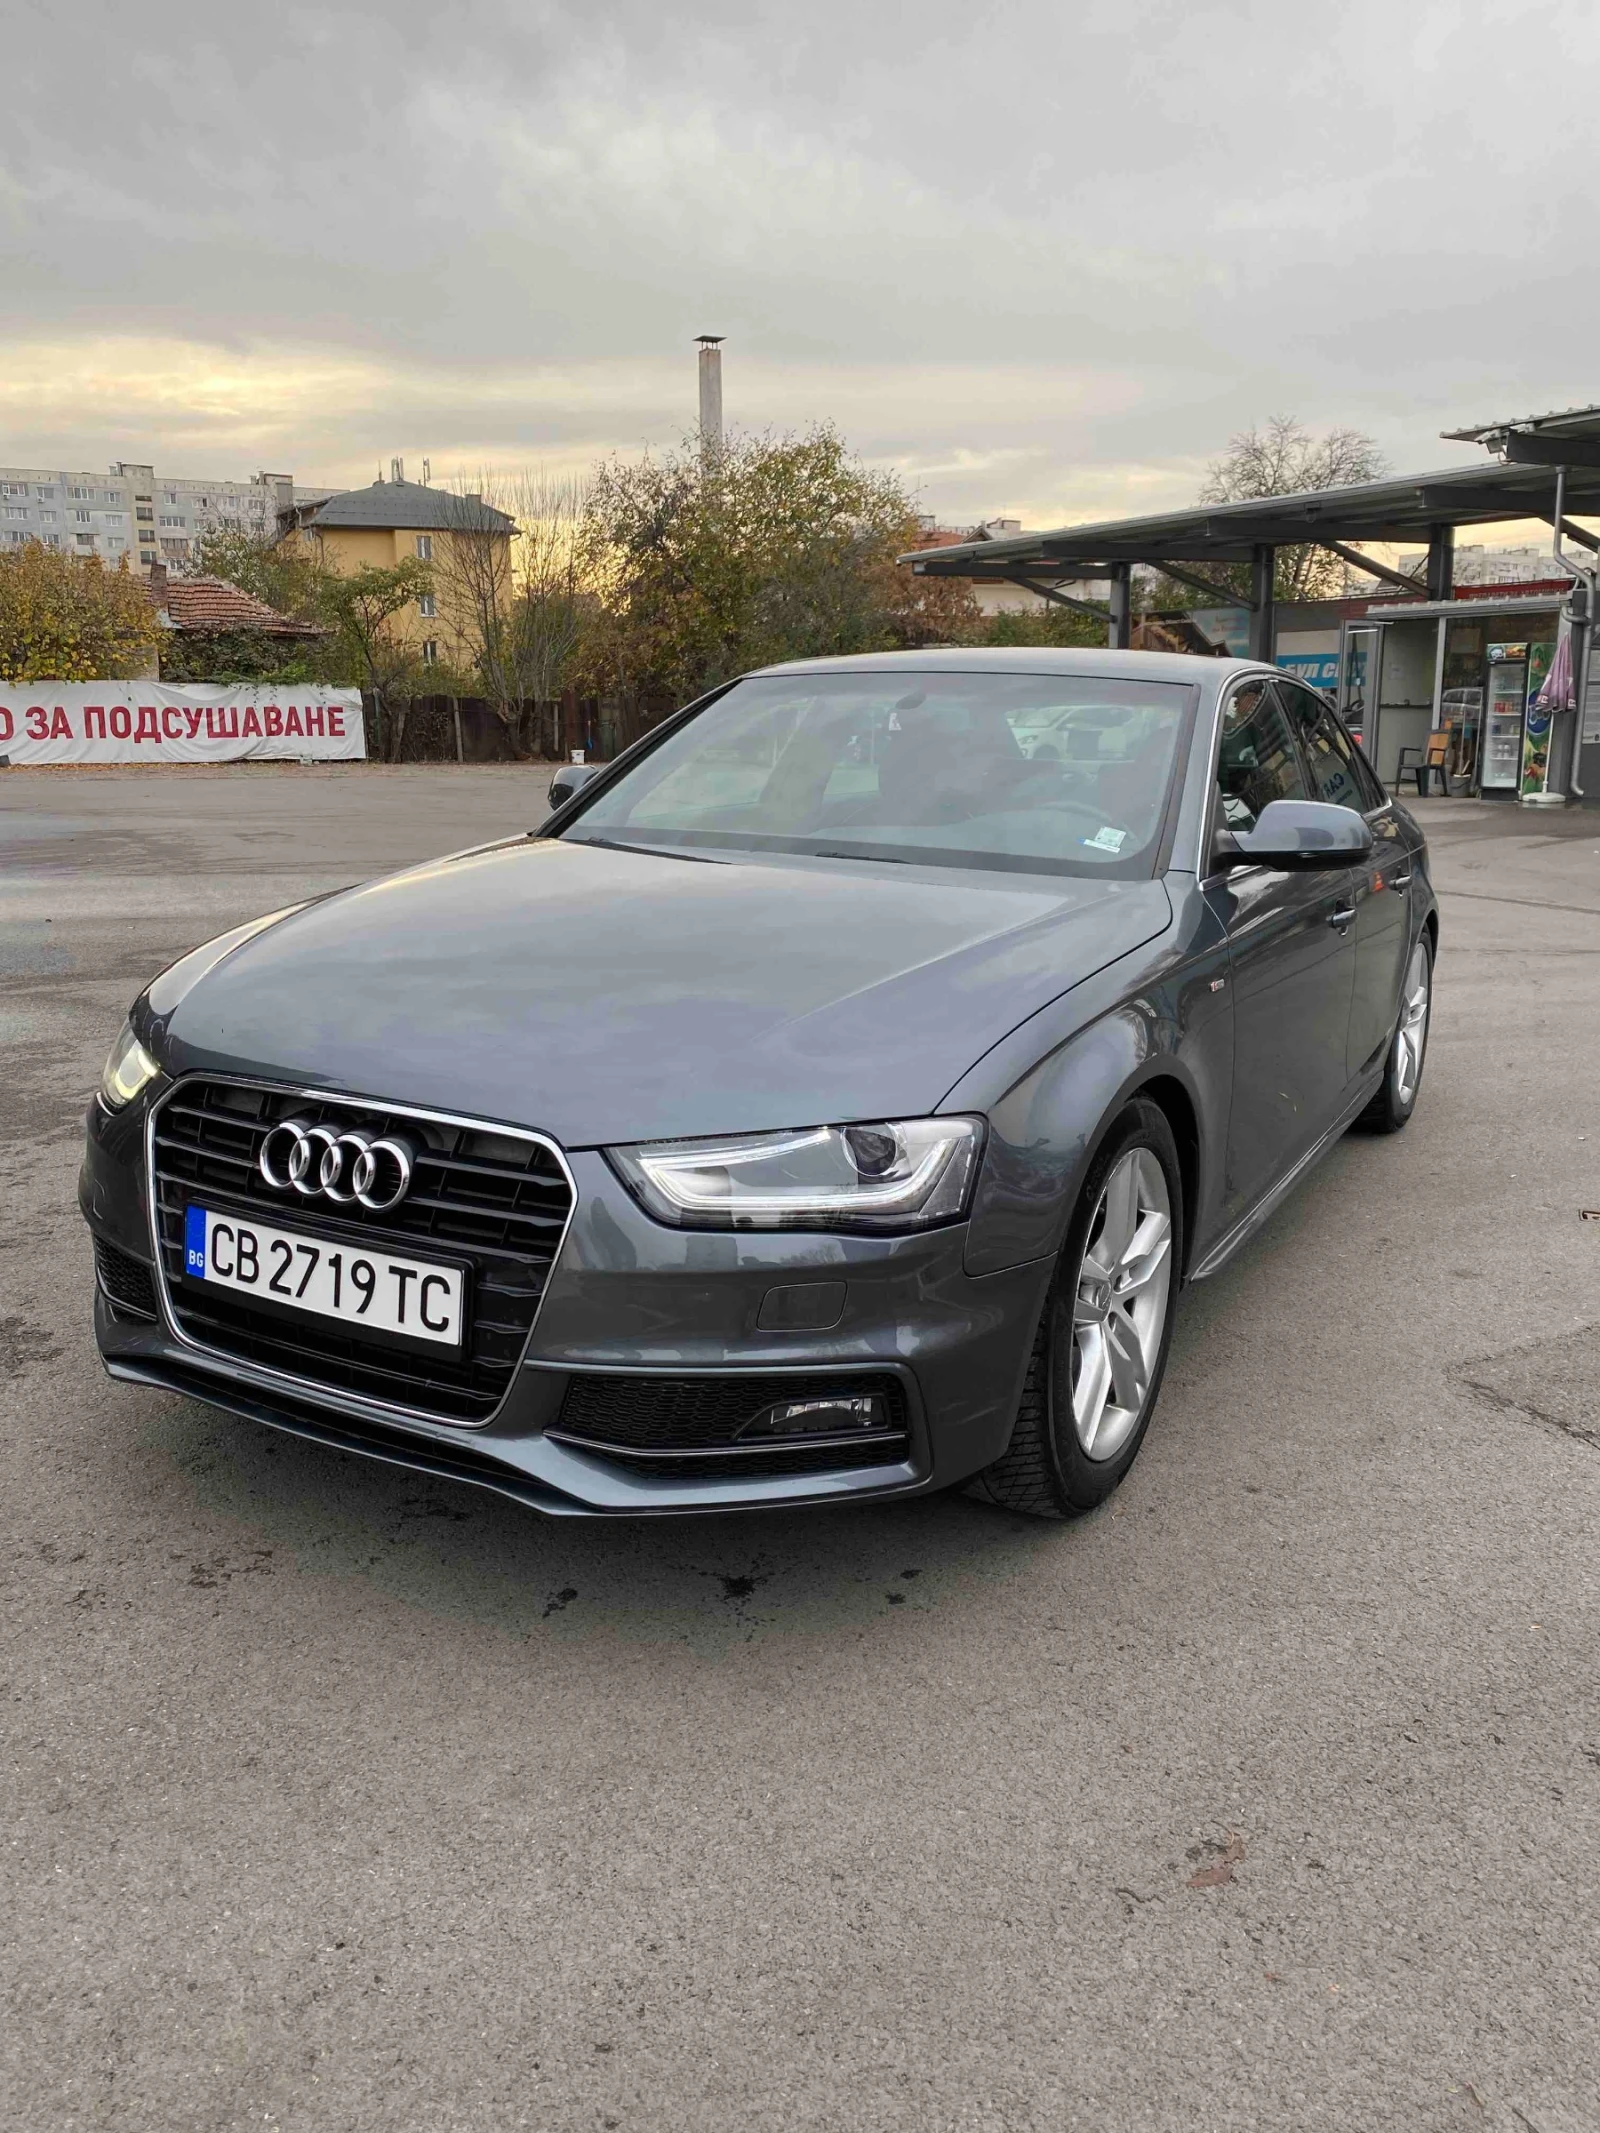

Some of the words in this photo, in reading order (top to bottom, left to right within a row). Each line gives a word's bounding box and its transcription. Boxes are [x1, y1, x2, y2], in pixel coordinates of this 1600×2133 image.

[26, 707, 74, 740] ЗА
[83, 706, 346, 743] ПОДСУШАВАНЕ
[188, 1249, 204, 1268] BG
[269, 1239, 376, 1314] 2719
